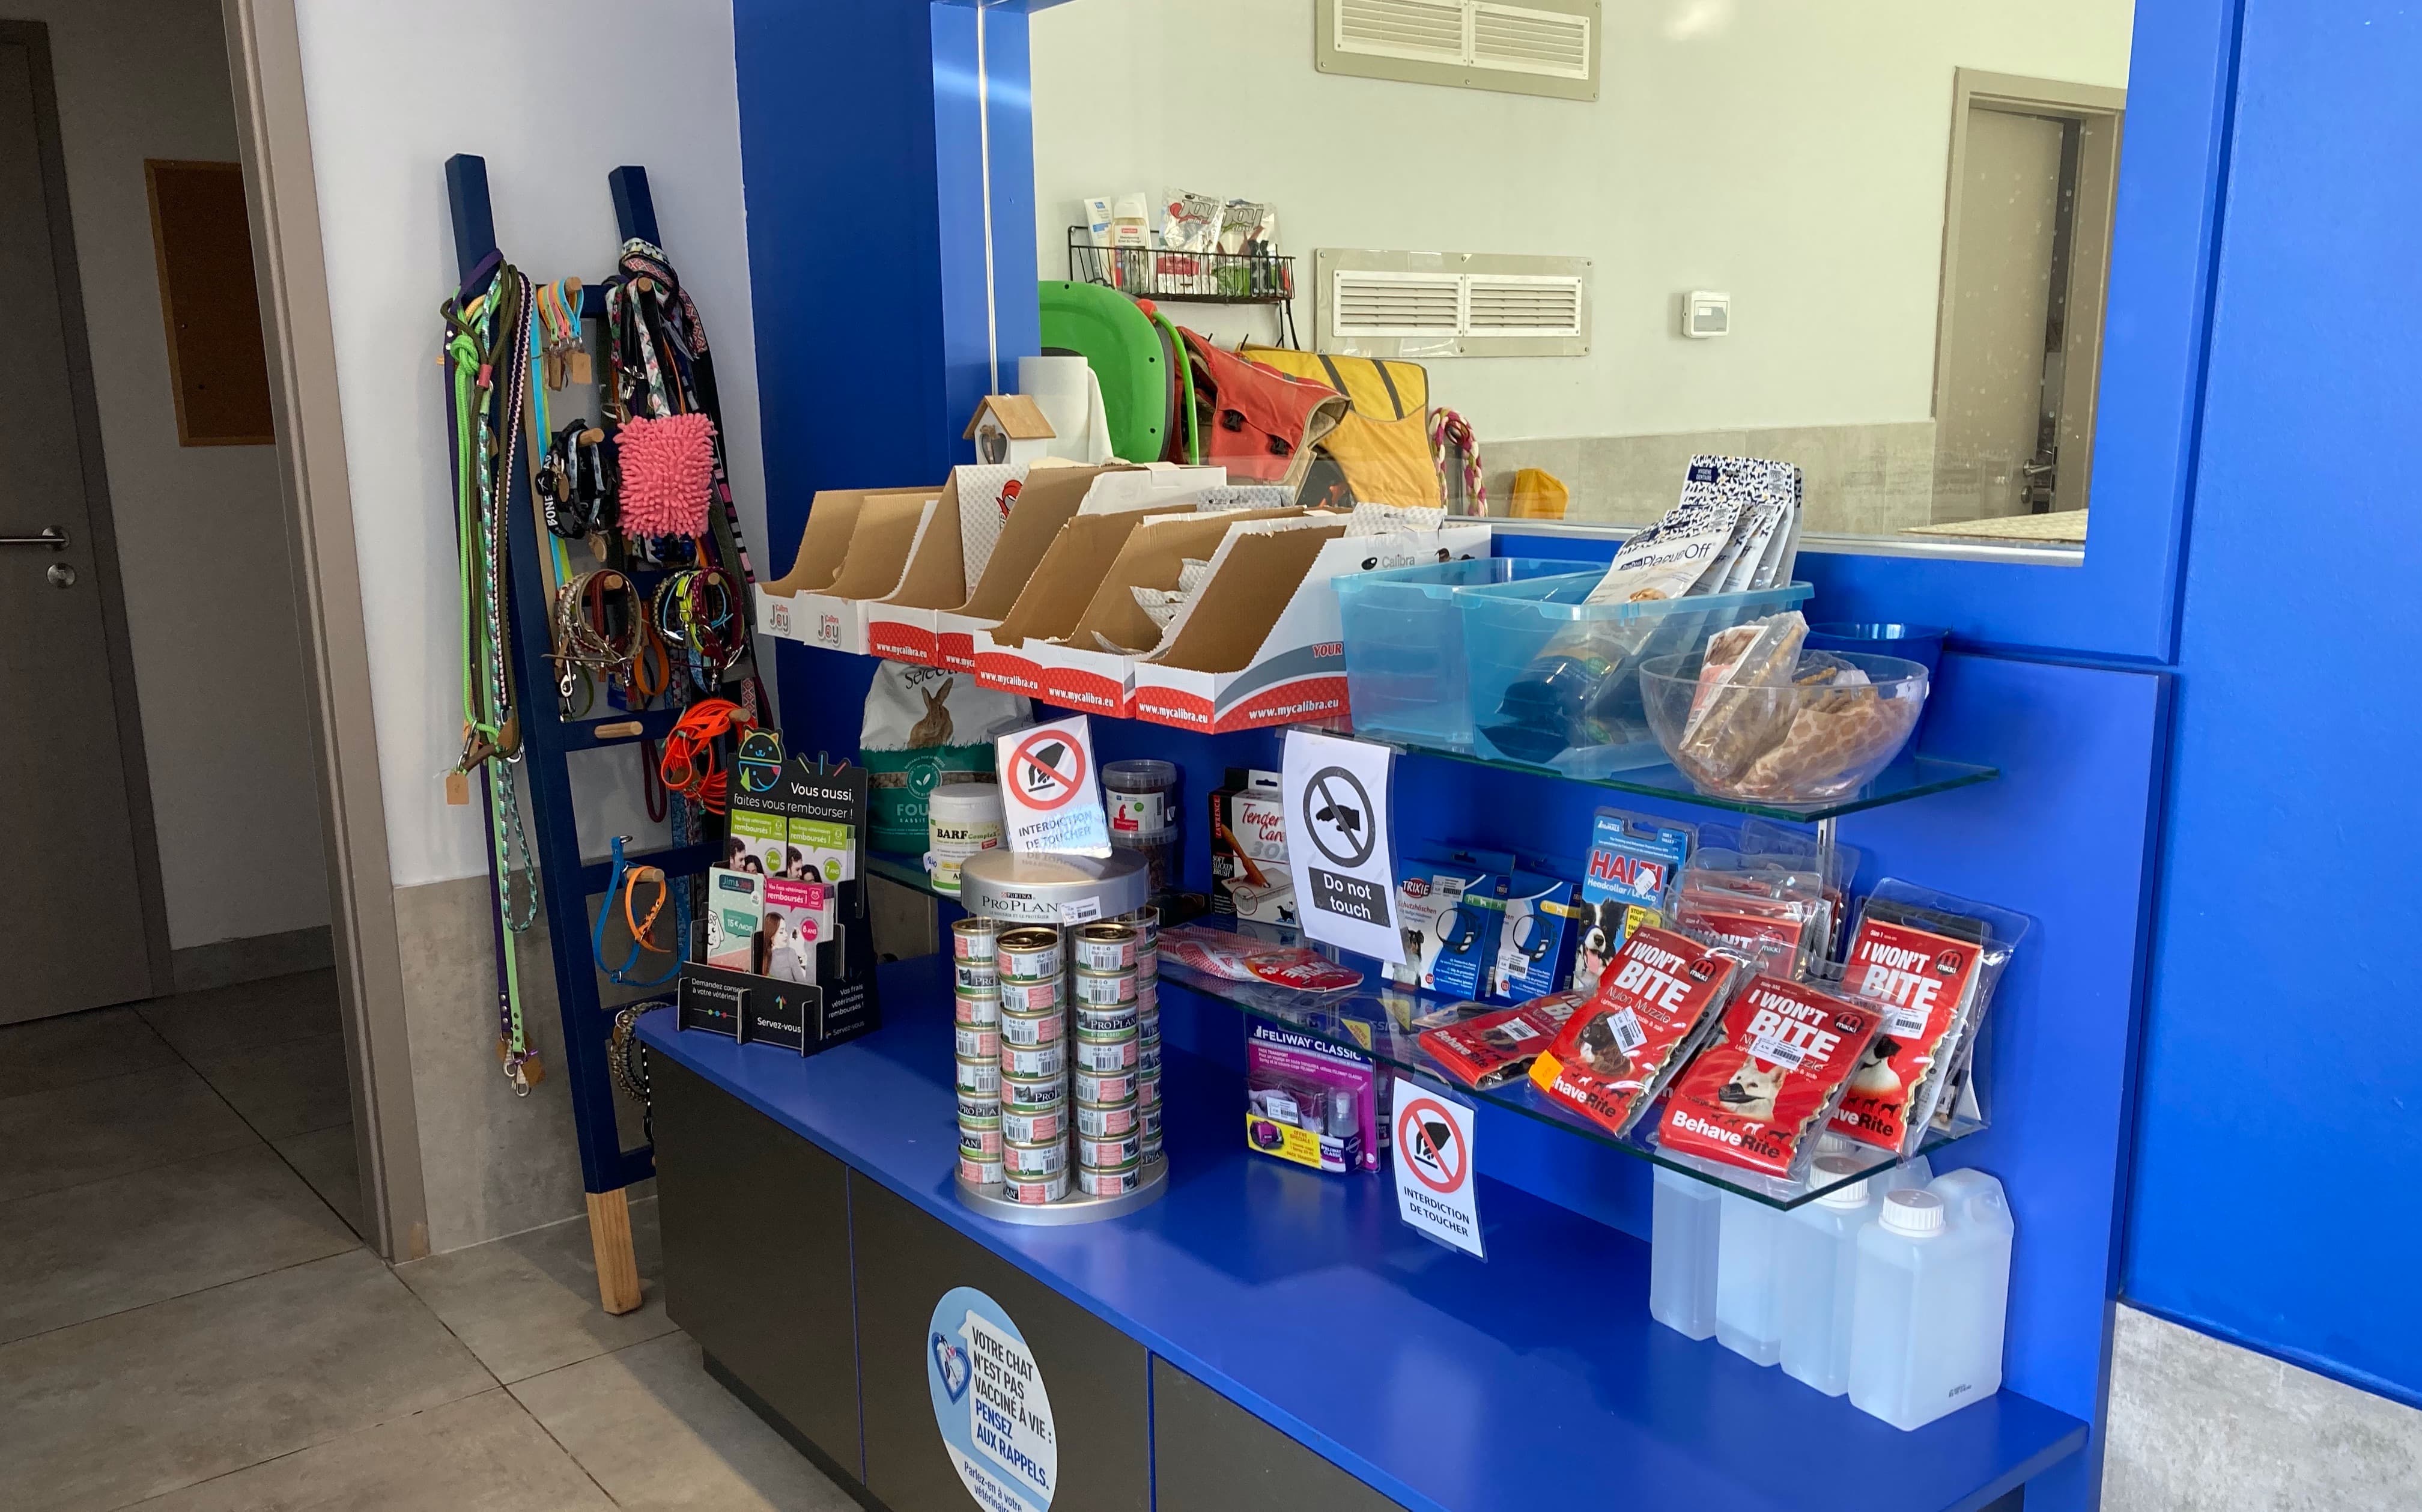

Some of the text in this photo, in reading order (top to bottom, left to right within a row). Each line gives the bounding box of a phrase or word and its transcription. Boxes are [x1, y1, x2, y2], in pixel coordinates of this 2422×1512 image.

[544, 494, 558, 526] BONE
[1382, 554, 1415, 568] Calibra
[770, 604, 789, 632] Joy
[776, 604, 788, 613] Calibra
[818, 615, 839, 643] Joy
[825, 615, 839, 624] Calibra
[876, 642, 927, 658] www.mycalibra.eu
[1312, 642, 1343, 658] YOUR
[946, 655, 975, 668] www.myca
[980, 671, 1038, 689] www.mycalibra.eu
[1049, 687, 1114, 707] www.mycalibra.eu
[1139, 702, 1208, 724] www.mycalibra.eu
[1249, 699, 1339, 719] www.mycalibra.eu
[791, 782, 854, 803] Vous aussi,
[734, 794, 853, 819] faites vous rembourser !
[897, 804, 929, 816] FOU
[1242, 803, 1283, 827] Tender
[734, 824, 768, 834] remboursés
[937, 828, 968, 839] BARF
[1018, 810, 1091, 837] INTERDICTION
[1259, 825, 1284, 842] Car
[791, 833, 827, 844] remboursés
[1026, 826, 1091, 849] DE TOUCHER
[1213, 861, 1233, 871] SLICKER
[1213, 868, 1230, 877] BRUSH
[1323, 872, 1372, 900] Do not
[1403, 880, 1430, 896] TRIXIE
[1588, 878, 1627, 895] Headcollar
[767, 891, 804, 903] remboursés
[1330, 895, 1371, 920] touch
[1398, 901, 1437, 915] Schutzhöschen
[1624, 941, 1686, 974] I WON'T
[1761, 945, 1781, 954] mikki
[1860, 941, 1931, 974] I WON'T
[1690, 968, 1708, 982] mikki
[1937, 963, 1956, 974] mikki
[692, 978, 722, 989] Demandez
[840, 983, 863, 996] Vos frais
[1614, 961, 1692, 1013] BITE
[1860, 965, 1943, 1013] BITE
[712, 991, 739, 1001] vétérinair
[831, 993, 864, 1008] vétérinaires
[1606, 986, 1671, 1024] Nylon Muzzle
[828, 1003, 860, 1019] remboursés
[1748, 989, 1829, 1025] I WON'T
[757, 1016, 801, 1033] Servez-vous
[1836, 1022, 1857, 1034] mikki
[1263, 1029, 1311, 1048] FELIWAY
[1314, 1040, 1362, 1061] CLASSIC
[1746, 1009, 1841, 1062] BITE
[1552, 1075, 1616, 1117] haveRite
[1672, 1110, 1781, 1159] BehaveRite
[1404, 1186, 1469, 1224] INTERDICTION
[1410, 1203, 1468, 1237] DE TOUCHER
[972, 1326, 1033, 1382] VOTRE CHAT
[974, 1350, 1024, 1400] N'EST PAS
[974, 1374, 1016, 1419] VACCINÉ
[1019, 1401, 1027, 1427] À
[1028, 1411, 1046, 1440] VIE
[976, 1398, 1013, 1441] PENSEZ
[977, 1422, 1049, 1491] AUX RAPPELS.
[964, 1460, 1022, 1512] Parlez-en à votre
